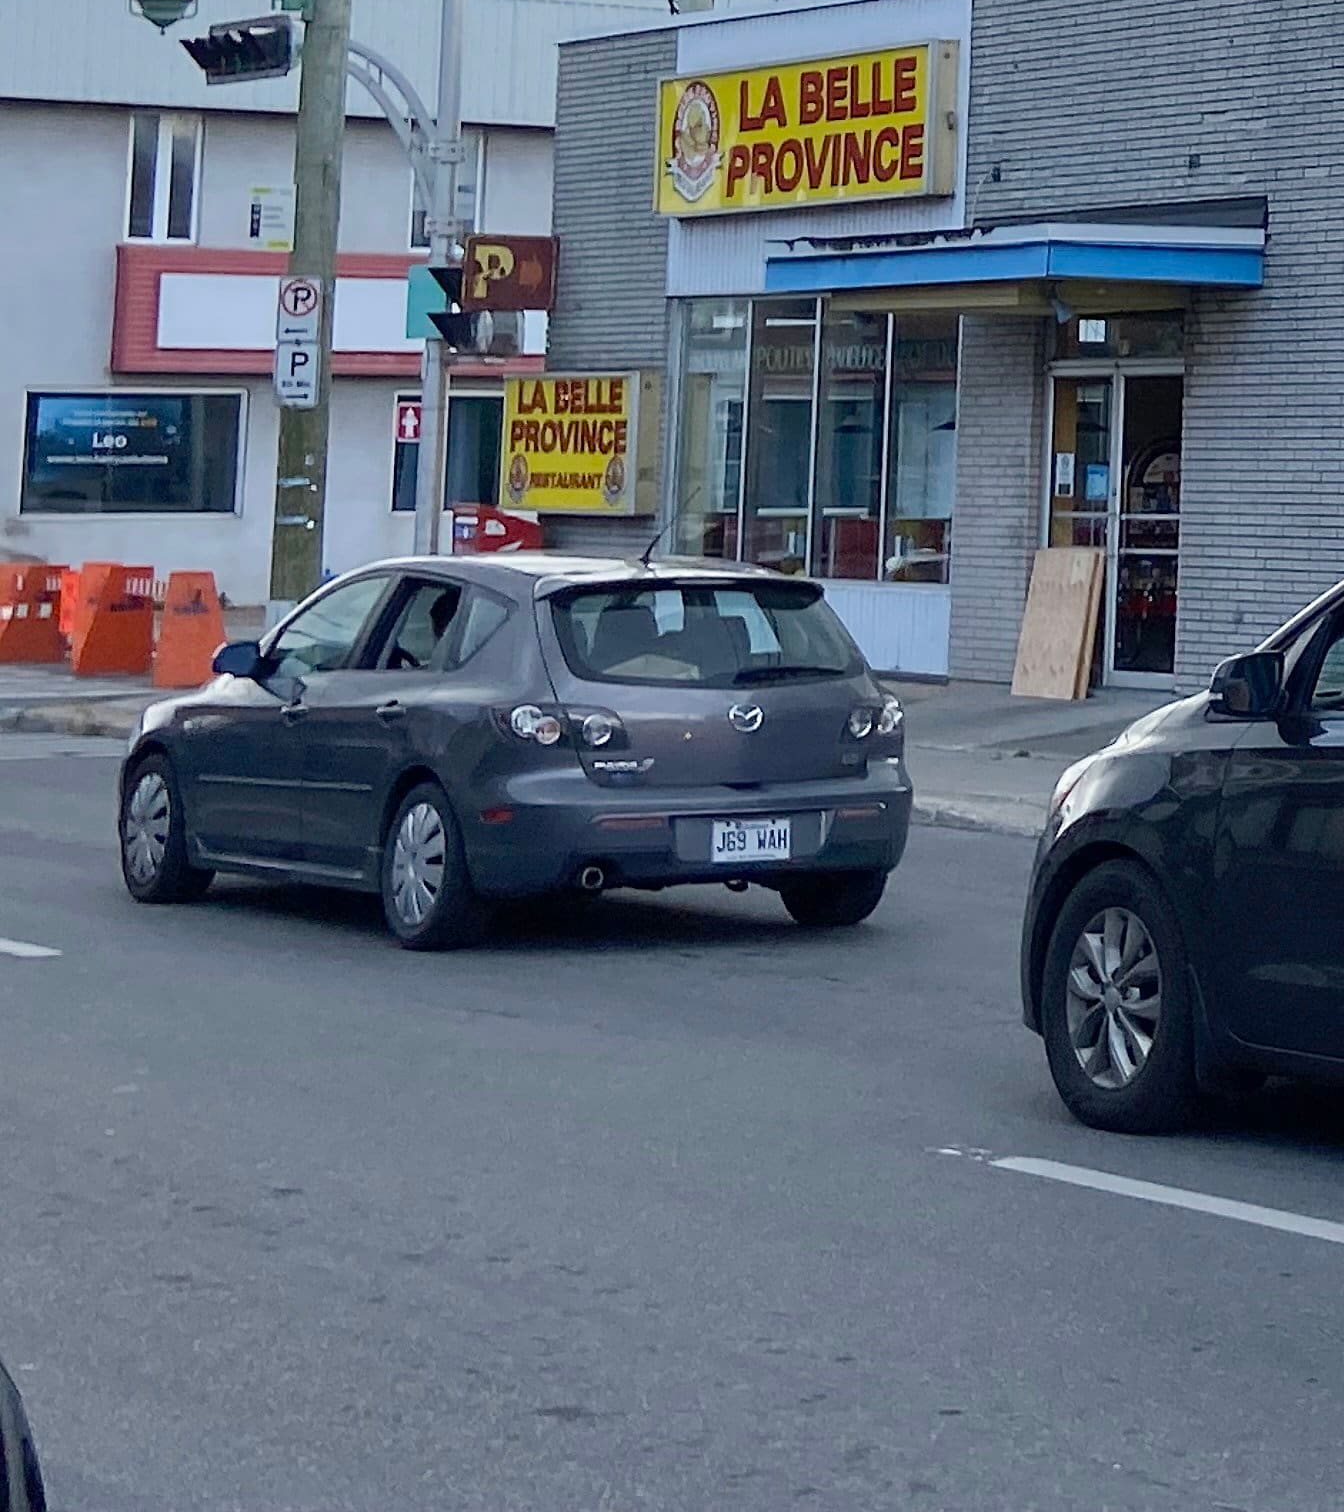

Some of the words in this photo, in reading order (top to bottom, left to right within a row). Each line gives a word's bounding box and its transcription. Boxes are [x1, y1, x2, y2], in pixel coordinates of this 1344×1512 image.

[739, 76, 788, 132] LA
[799, 55, 918, 126] BELLE
[725, 123, 925, 198] PROVINCE
[291, 352, 309, 377] P
[517, 378, 548, 415] LA
[554, 378, 624, 415] BELLE
[510, 419, 628, 455] PROVINCE
[716, 830, 746, 853] J69
[757, 828, 787, 851] WAH
